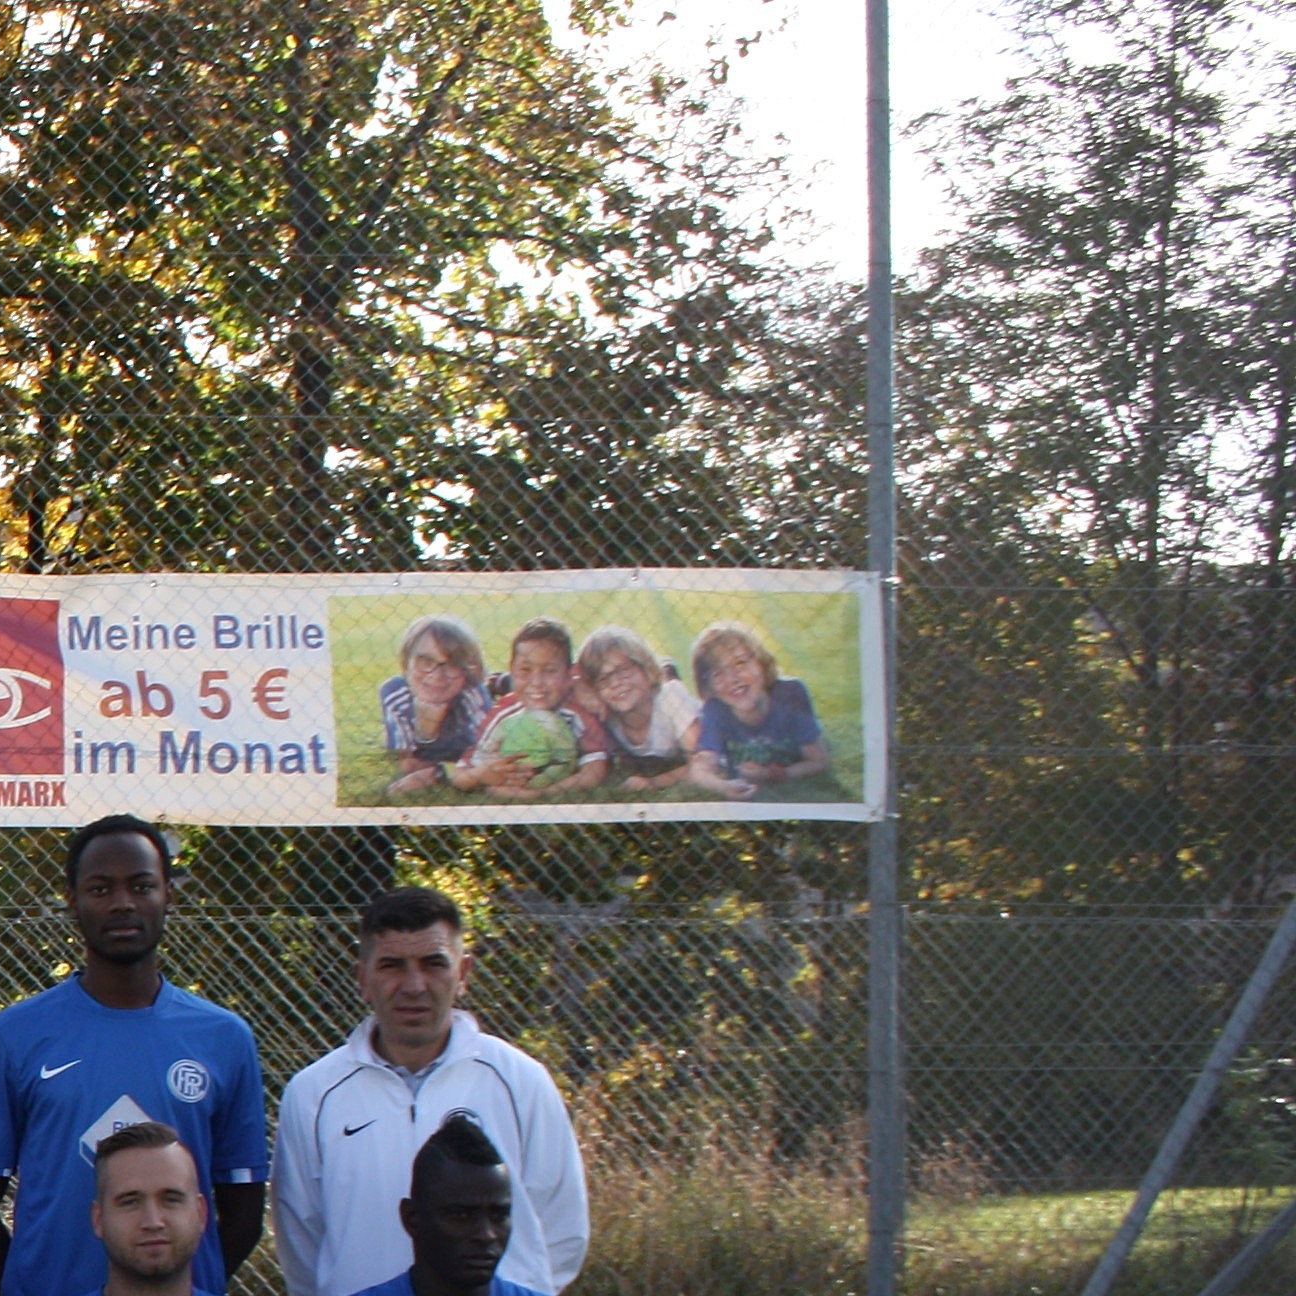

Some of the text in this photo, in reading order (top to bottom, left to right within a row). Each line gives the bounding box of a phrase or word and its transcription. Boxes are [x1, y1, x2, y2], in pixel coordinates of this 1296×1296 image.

[67, 614, 325, 651] Meine Brille
[99, 668, 292, 720] ab 5 €
[73, 730, 328, 775] im Monat
